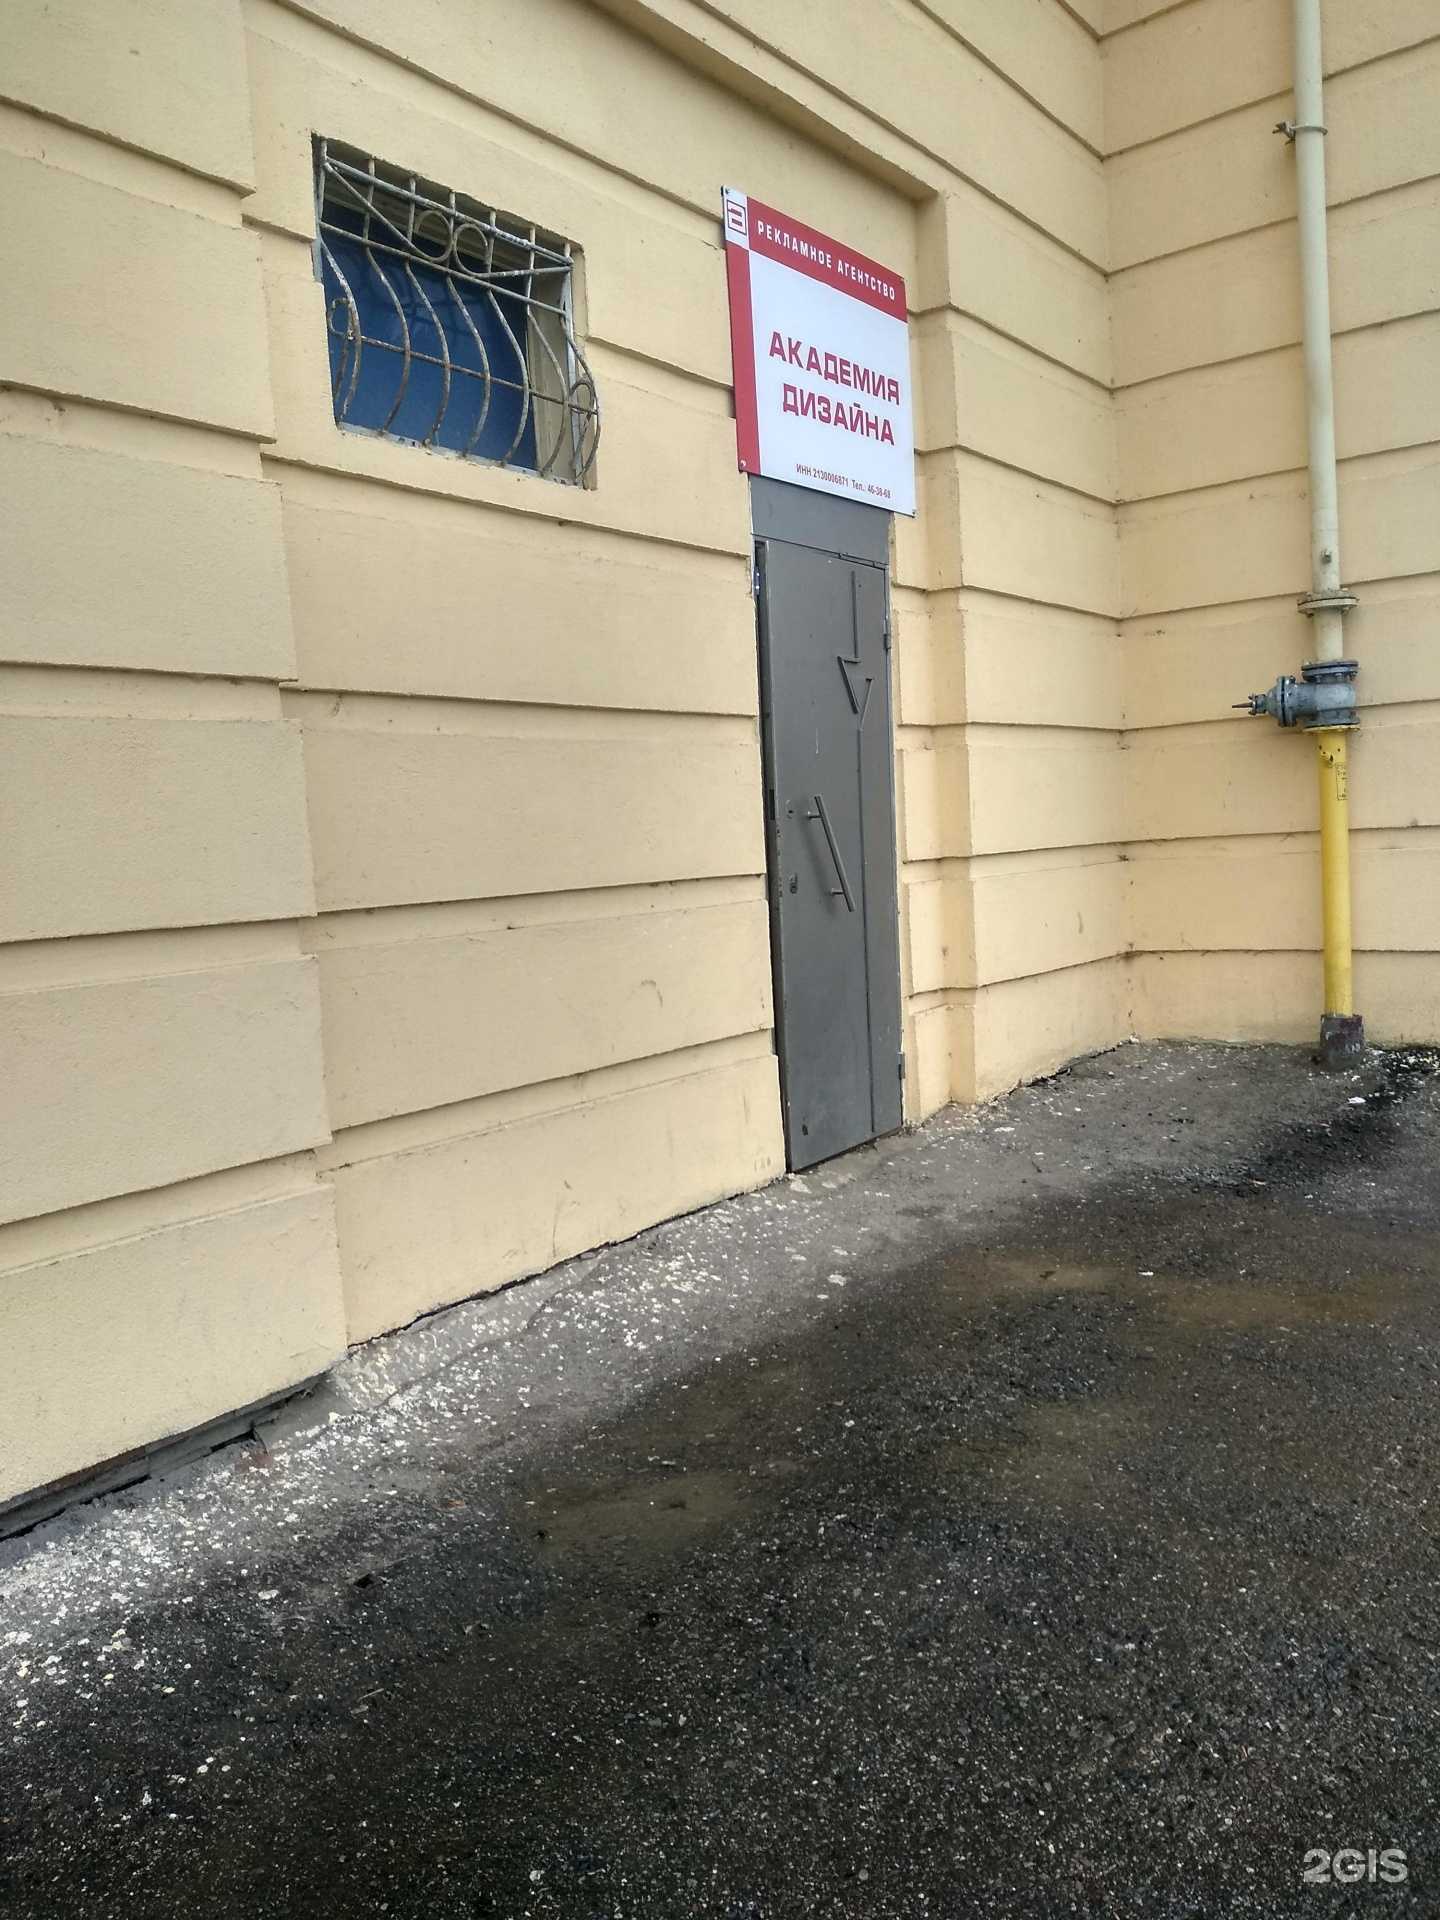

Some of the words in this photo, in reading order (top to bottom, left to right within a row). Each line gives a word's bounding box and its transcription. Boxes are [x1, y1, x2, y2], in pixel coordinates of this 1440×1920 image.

[757, 219, 832, 270] РЕКЛАМНОЕ
[837, 259, 895, 301] АГЕНТСТВО
[769, 331, 900, 406] АКАДЕМИЯ
[782, 383, 895, 446] ДИЗАЙНА
[796, 463, 812, 477] ИНН
